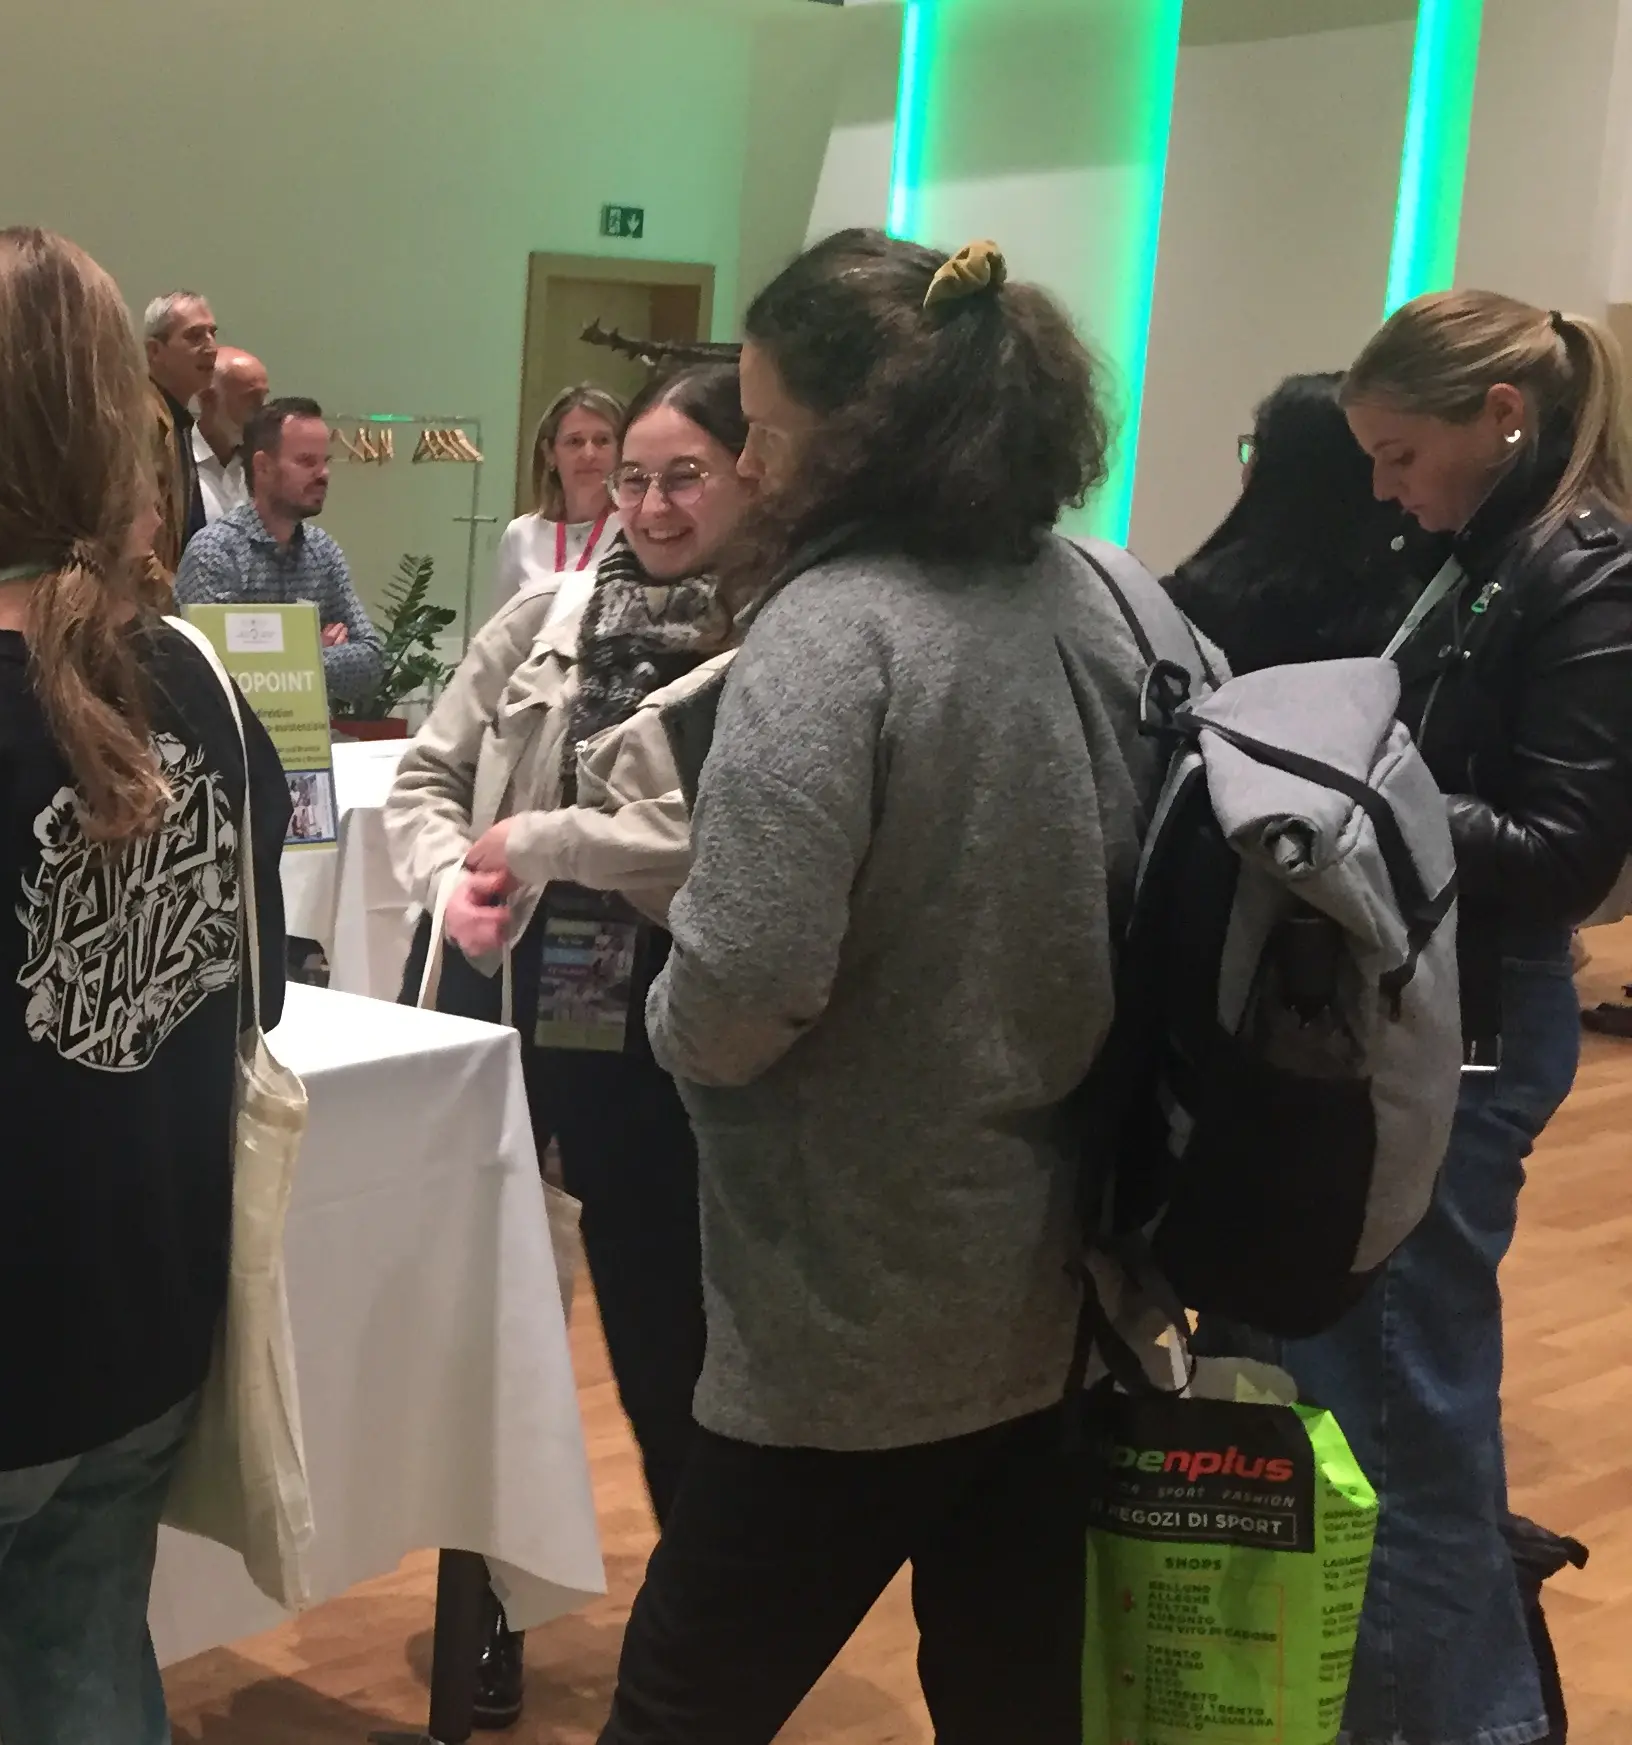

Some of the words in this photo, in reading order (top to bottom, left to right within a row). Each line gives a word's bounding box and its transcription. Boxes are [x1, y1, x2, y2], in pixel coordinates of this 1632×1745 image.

[231, 671, 316, 693] OPOINT
[1110, 1445, 1295, 1482] penplus
[1187, 1512, 1209, 1528] DI
[1214, 1513, 1284, 1535] SPORT
